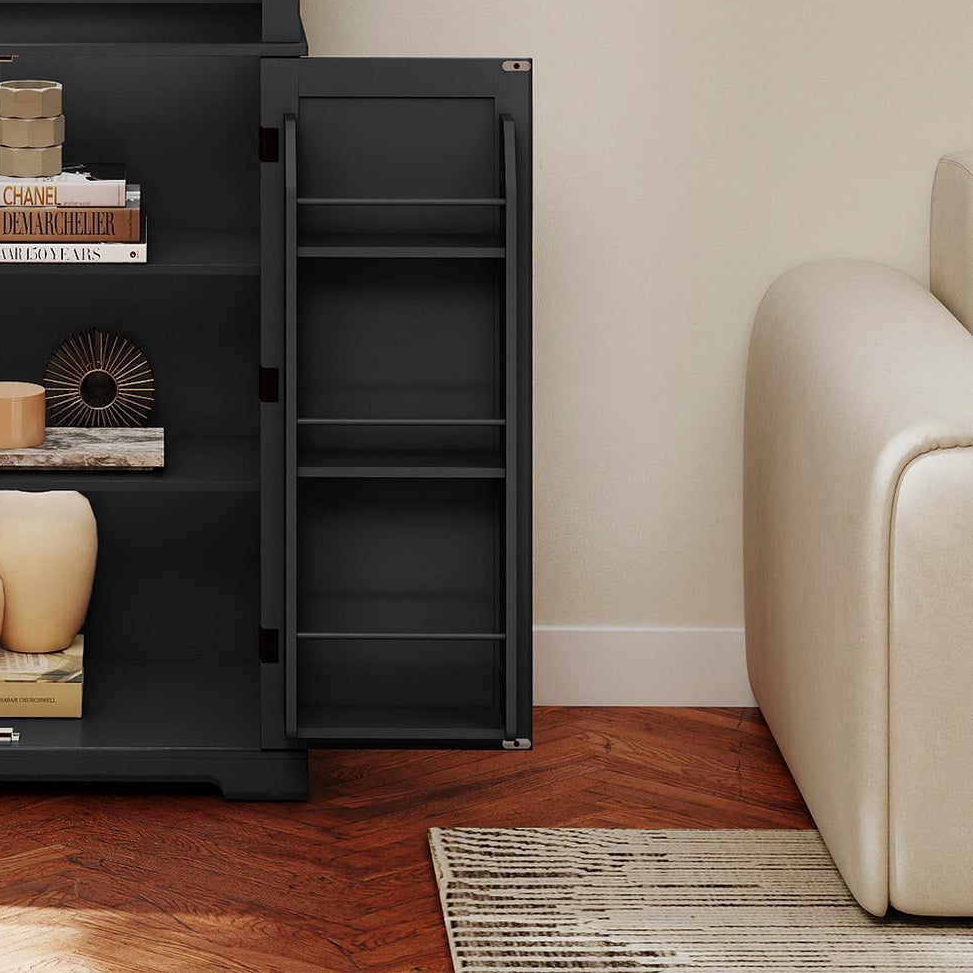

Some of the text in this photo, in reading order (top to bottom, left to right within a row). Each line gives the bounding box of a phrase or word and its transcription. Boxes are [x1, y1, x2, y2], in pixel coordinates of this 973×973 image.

[3, 186, 61, 206] CHANEL
[3, 211, 116, 235] DEMARCHELIER
[49, 247, 101, 261] YEARS
